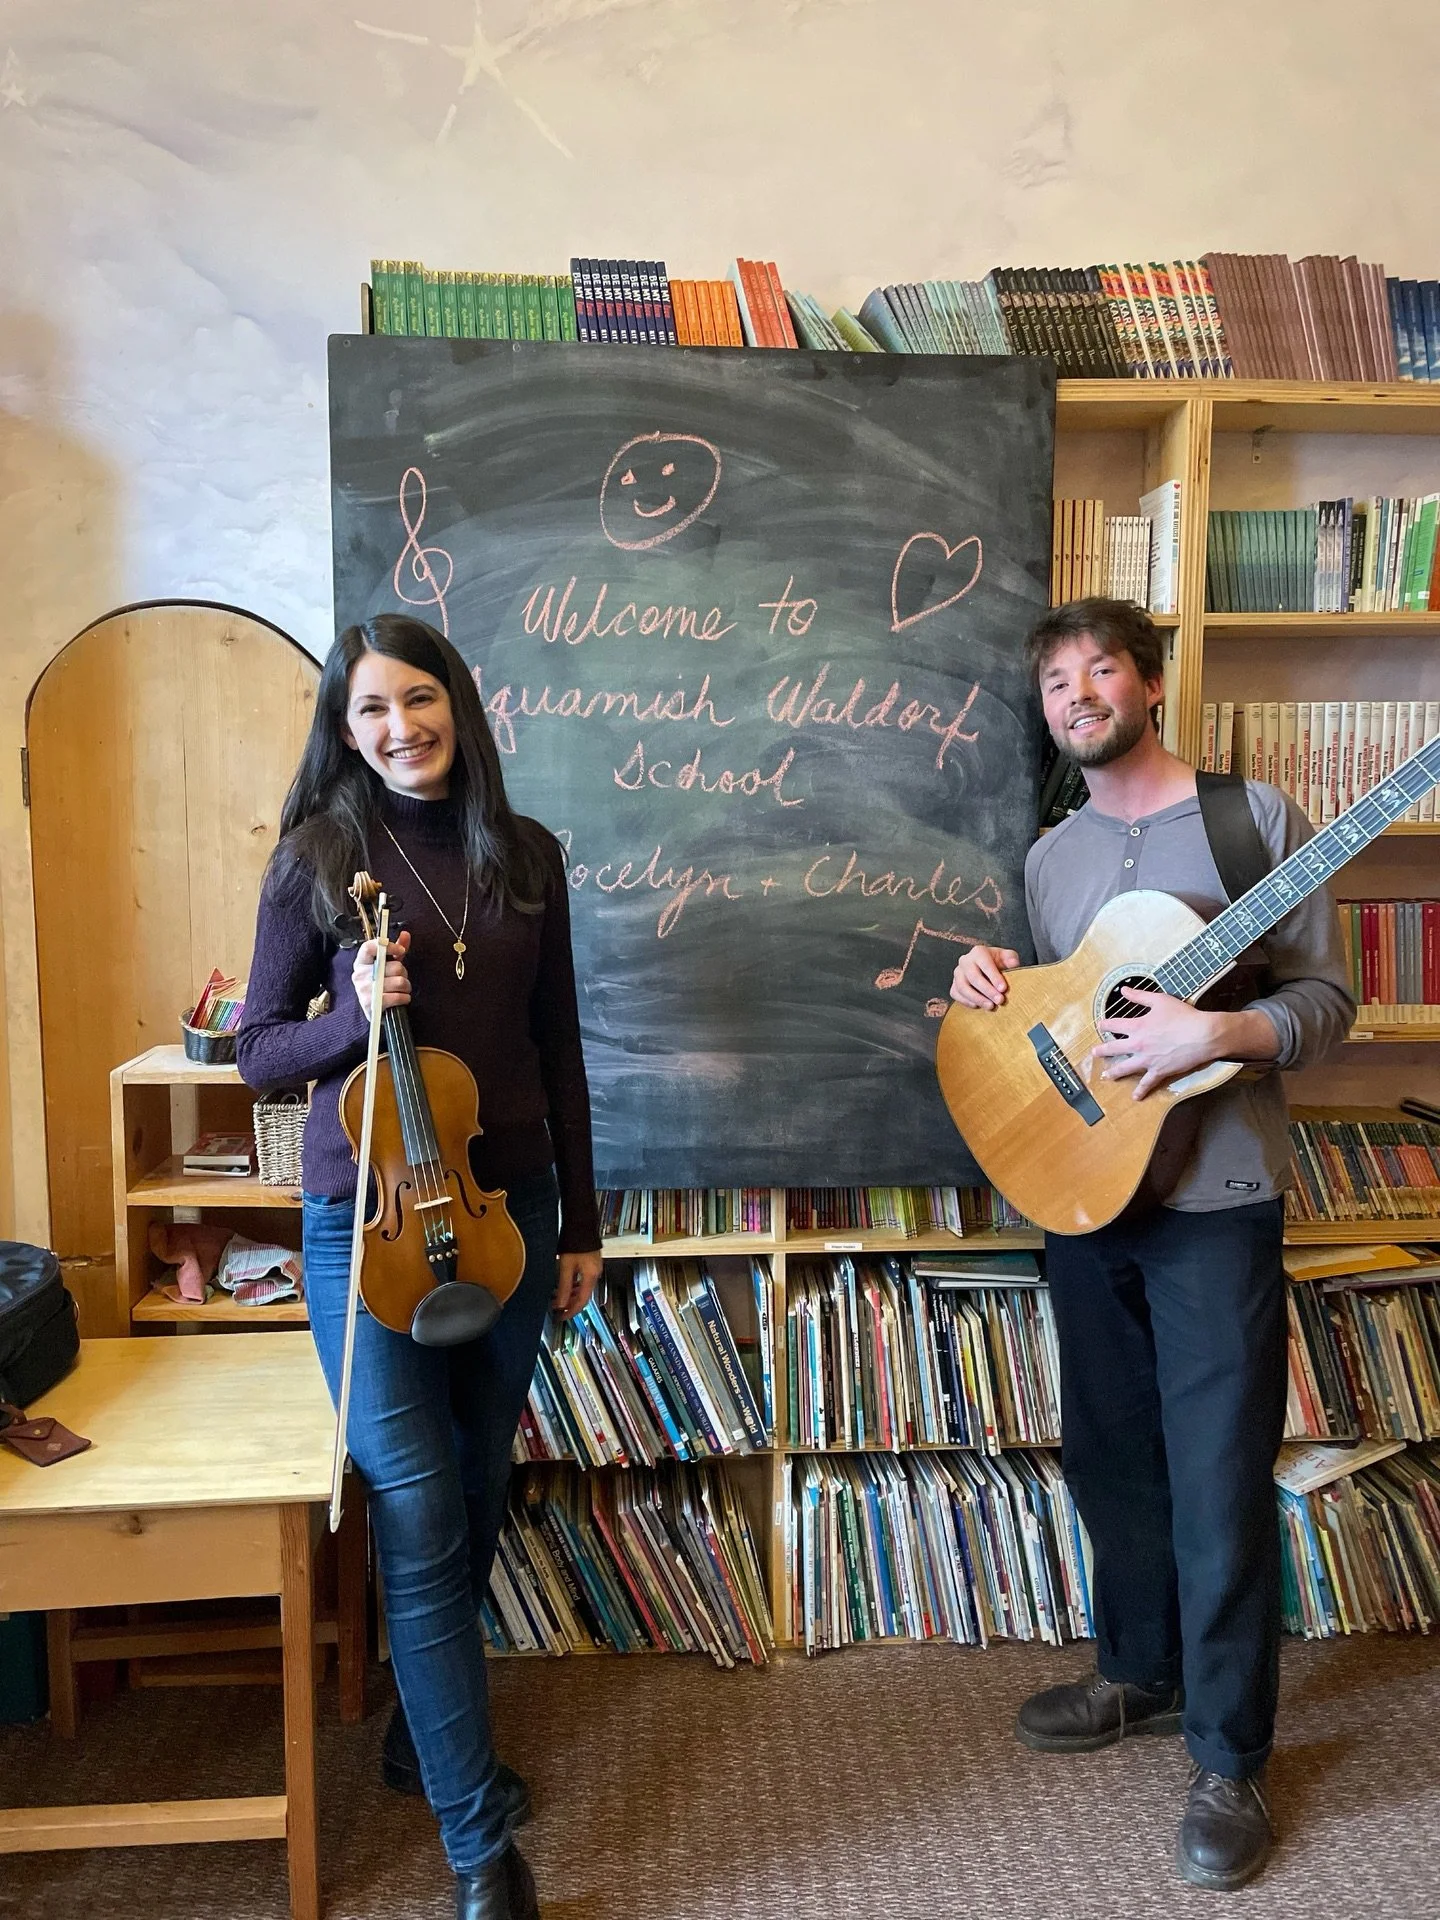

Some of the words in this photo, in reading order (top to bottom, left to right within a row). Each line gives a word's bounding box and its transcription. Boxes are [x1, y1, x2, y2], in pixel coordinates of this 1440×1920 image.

[573, 272, 582, 283] BE
[582, 274, 591, 285] BE
[592, 273, 601, 285] BE
[602, 274, 610, 285] BE
[611, 274, 620, 285] BE
[621, 274, 630, 285] BE
[630, 276, 639, 287] BE
[640, 275, 649, 286] BE
[649, 275, 658, 287] BE
[659, 276, 668, 287] BE
[574, 286, 584, 299] MY
[584, 288, 593, 300] MY
[594, 287, 603, 299] MY
[604, 288, 613, 300] MY
[613, 288, 622, 300] MY
[623, 288, 632, 300] MY
[632, 290, 641, 302] MY
[642, 289, 651, 301] MY
[651, 289, 660, 302] MY
[660, 290, 670, 302] MY
[1005, 309, 1013, 323] The
[1010, 324, 1020, 349] Bronze
[1108, 302, 1125, 339] KARMA
[1119, 303, 1136, 340] KARMA
[1134, 301, 1150, 338] KARMA
[1143, 303, 1160, 339] KARMA
[1159, 300, 1174, 336] KARMA
[1168, 302, 1183, 338] KARMA
[1183, 299, 1198, 336] KARMA
[1195, 299, 1210, 336] KARMA
[1207, 298, 1224, 336] KARMA
[1021, 324, 1032, 349] Bronze
[1033, 324, 1044, 349] Bronze
[1045, 324, 1056, 349] Bronze
[1052, 309, 1060, 323] The
[1057, 324, 1068, 350] Bronze
[1064, 350, 1072, 365] Bow
[1069, 325, 1079, 349] Bronze
[1076, 350, 1084, 366] Bow
[1081, 324, 1092, 348] Bronze
[1088, 349, 1096, 365] Bow
[1088, 308, 1096, 322] The
[1093, 324, 1105, 348] Bronze
[1100, 350, 1108, 365] Bow
[1106, 322, 1117, 346] Bronze
[1114, 348, 1122, 363] Bow
[521, 576, 738, 645] Welcome
[758, 575, 817, 636] to
[768, 663, 979, 770] Waldorf
[613, 739, 805, 809] School
[803, 853, 1003, 916] Charles
[707, 1320, 726, 1354] Natural
[721, 1354, 741, 1394] Wonders
[853, 1333, 861, 1368] KLONDIKE
[648, 1357, 662, 1384] GALAXIES
[649, 1301, 669, 1341] SCHOLASTIC
[667, 1342, 682, 1370] CANADA
[680, 1371, 694, 1390] ATLAS
[697, 1408, 711, 1432] WORLD
[848, 1543, 856, 1568] CHRISTMAS
[1066, 1524, 1078, 1570] THANKSGIVING
[552, 1549, 567, 1568] Body
[560, 1569, 572, 1582] and
[567, 1582, 580, 1601] Mind
